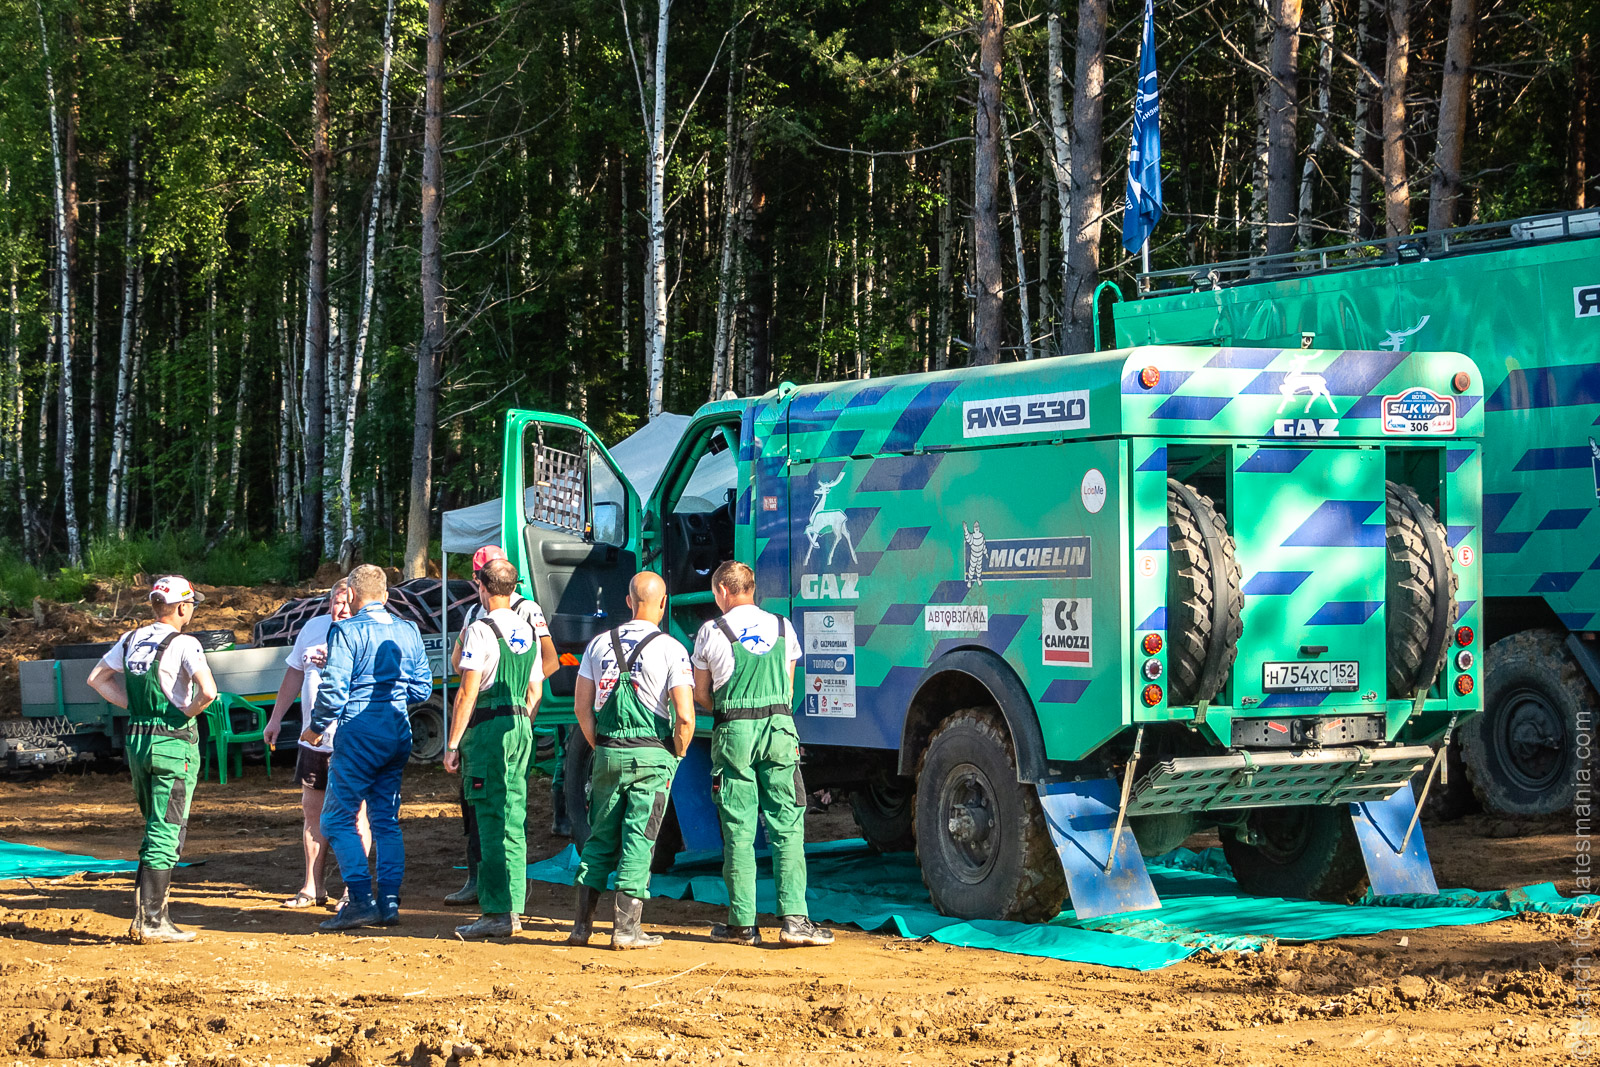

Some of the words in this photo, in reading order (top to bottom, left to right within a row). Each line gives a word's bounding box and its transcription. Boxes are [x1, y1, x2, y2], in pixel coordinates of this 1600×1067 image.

[1022, 398, 1086, 425] 530
[1389, 403, 1420, 414] SILK
[1421, 403, 1448, 414] WAY
[1273, 418, 1340, 437] GAZ
[1410, 422, 1429, 432] 306
[988, 546, 1087, 568] MICHELIN
[800, 572, 860, 600] GAZ
[927, 610, 987, 627] АВТОВЗГЛЯД
[1044, 634, 1090, 650] CAMOZZI
[1332, 664, 1354, 678] 152
